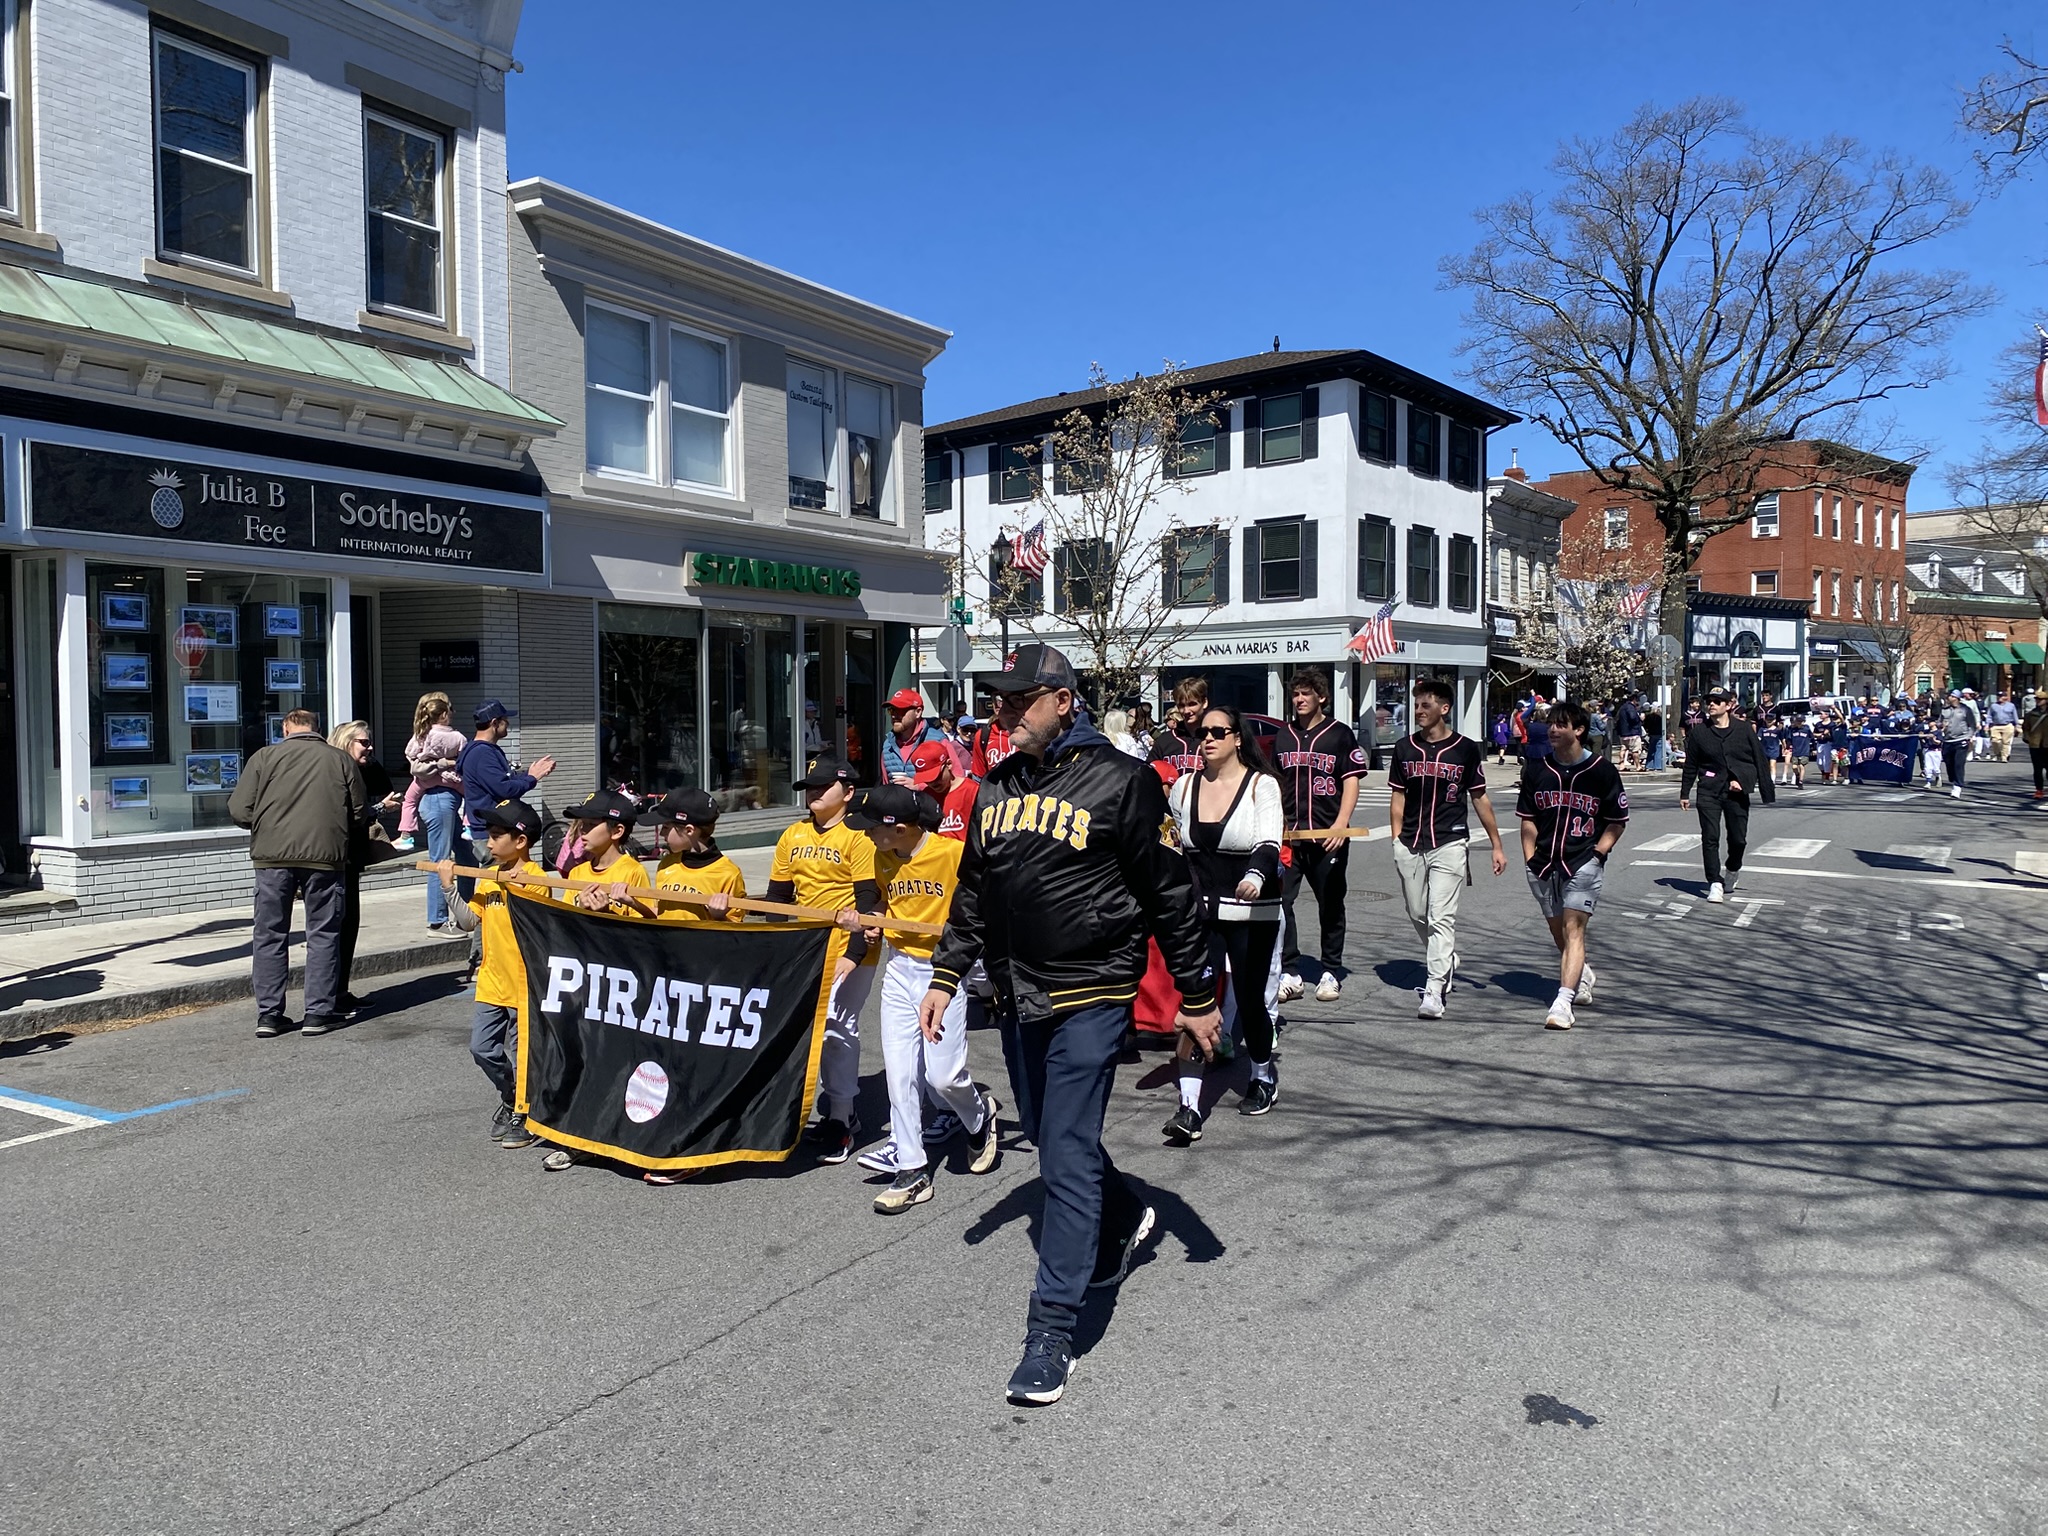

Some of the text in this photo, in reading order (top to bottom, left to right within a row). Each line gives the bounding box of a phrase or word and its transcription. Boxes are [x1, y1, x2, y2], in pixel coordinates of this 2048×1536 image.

[790, 390, 809, 403] Custom
[200, 473, 286, 508] Julia B
[244, 514, 287, 543] Fee
[339, 492, 473, 545] Sotheby's
[340, 537, 473, 560] INTERNATIONAL REALTY
[693, 552, 862, 598] STARBUCKS
[1202, 640, 1310, 656] ANNA MARIA'S BAR
[915, 758, 926, 768] C
[987, 745, 1016, 765] Red
[1879, 748, 1908, 768] SOX
[808, 760, 816, 774] P
[1313, 776, 1337, 796] 26
[1445, 783, 1459, 803] 2
[1534, 790, 1601, 816] GARNETS
[938, 809, 964, 830] eds
[981, 793, 1091, 851] PIRATES
[1571, 816, 1595, 837] 14
[789, 846, 841, 865] PIRATES
[887, 879, 944, 899] PIRATES
[540, 956, 770, 1050] PIRATES
